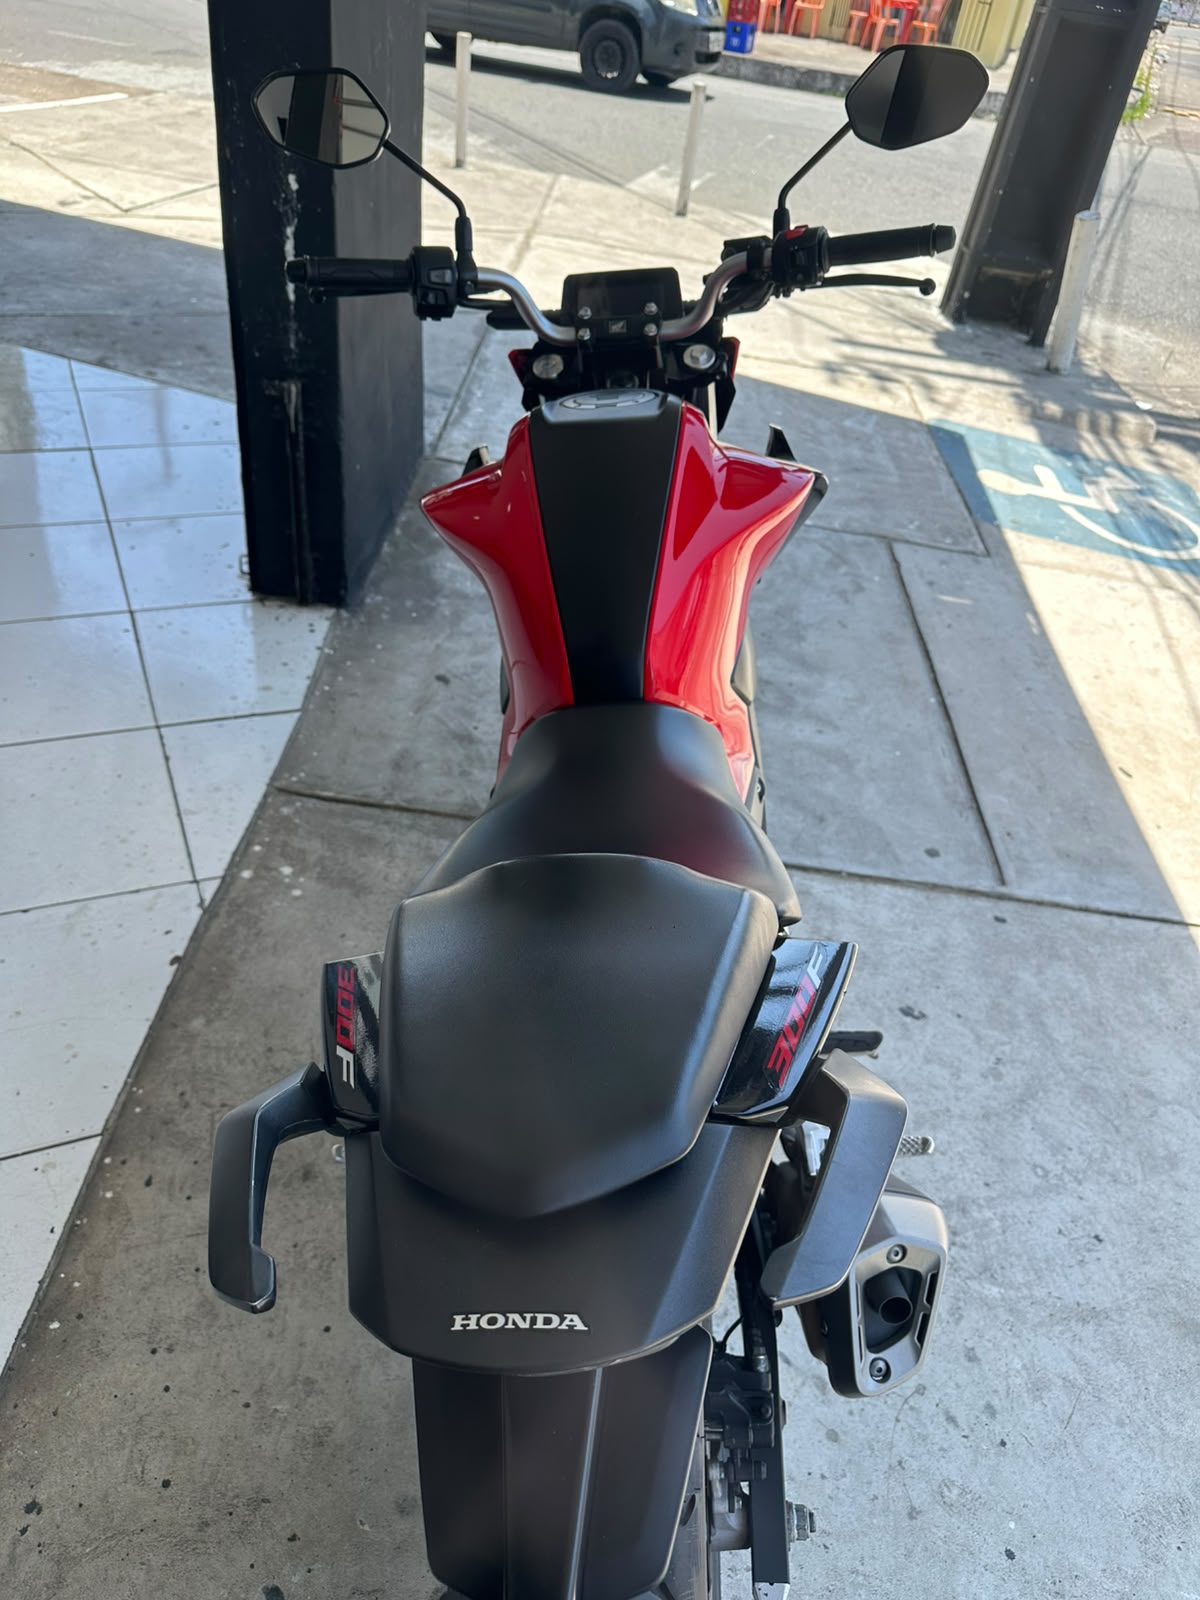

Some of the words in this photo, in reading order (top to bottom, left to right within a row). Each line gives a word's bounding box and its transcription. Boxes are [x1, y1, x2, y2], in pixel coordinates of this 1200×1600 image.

[336, 965, 355, 1089] 300F
[767, 945, 823, 1089] 300F
[450, 1312, 589, 1331] HONDA
